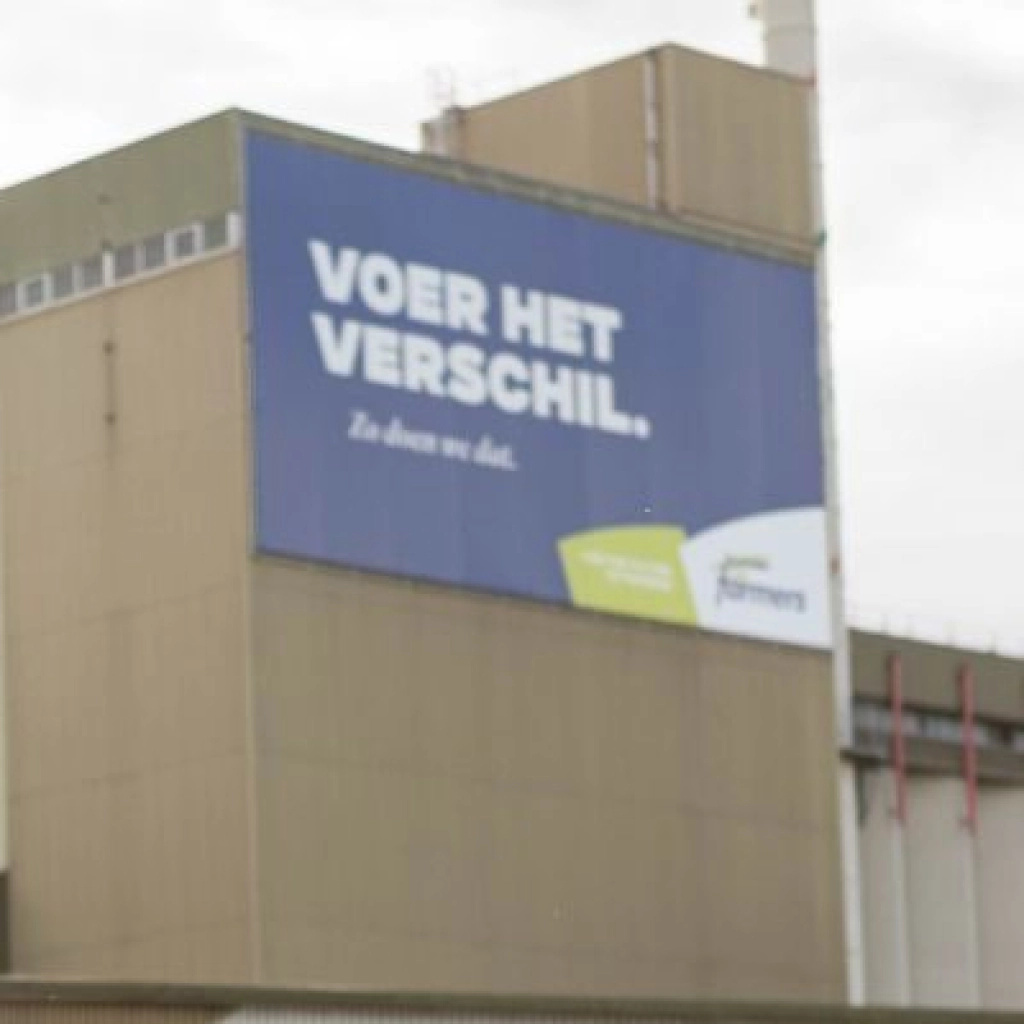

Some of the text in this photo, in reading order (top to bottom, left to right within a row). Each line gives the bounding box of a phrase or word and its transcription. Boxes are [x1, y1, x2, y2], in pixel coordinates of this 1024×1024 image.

[308, 239, 622, 362] VOER HET
[310, 311, 651, 440] VERSCHIL.
